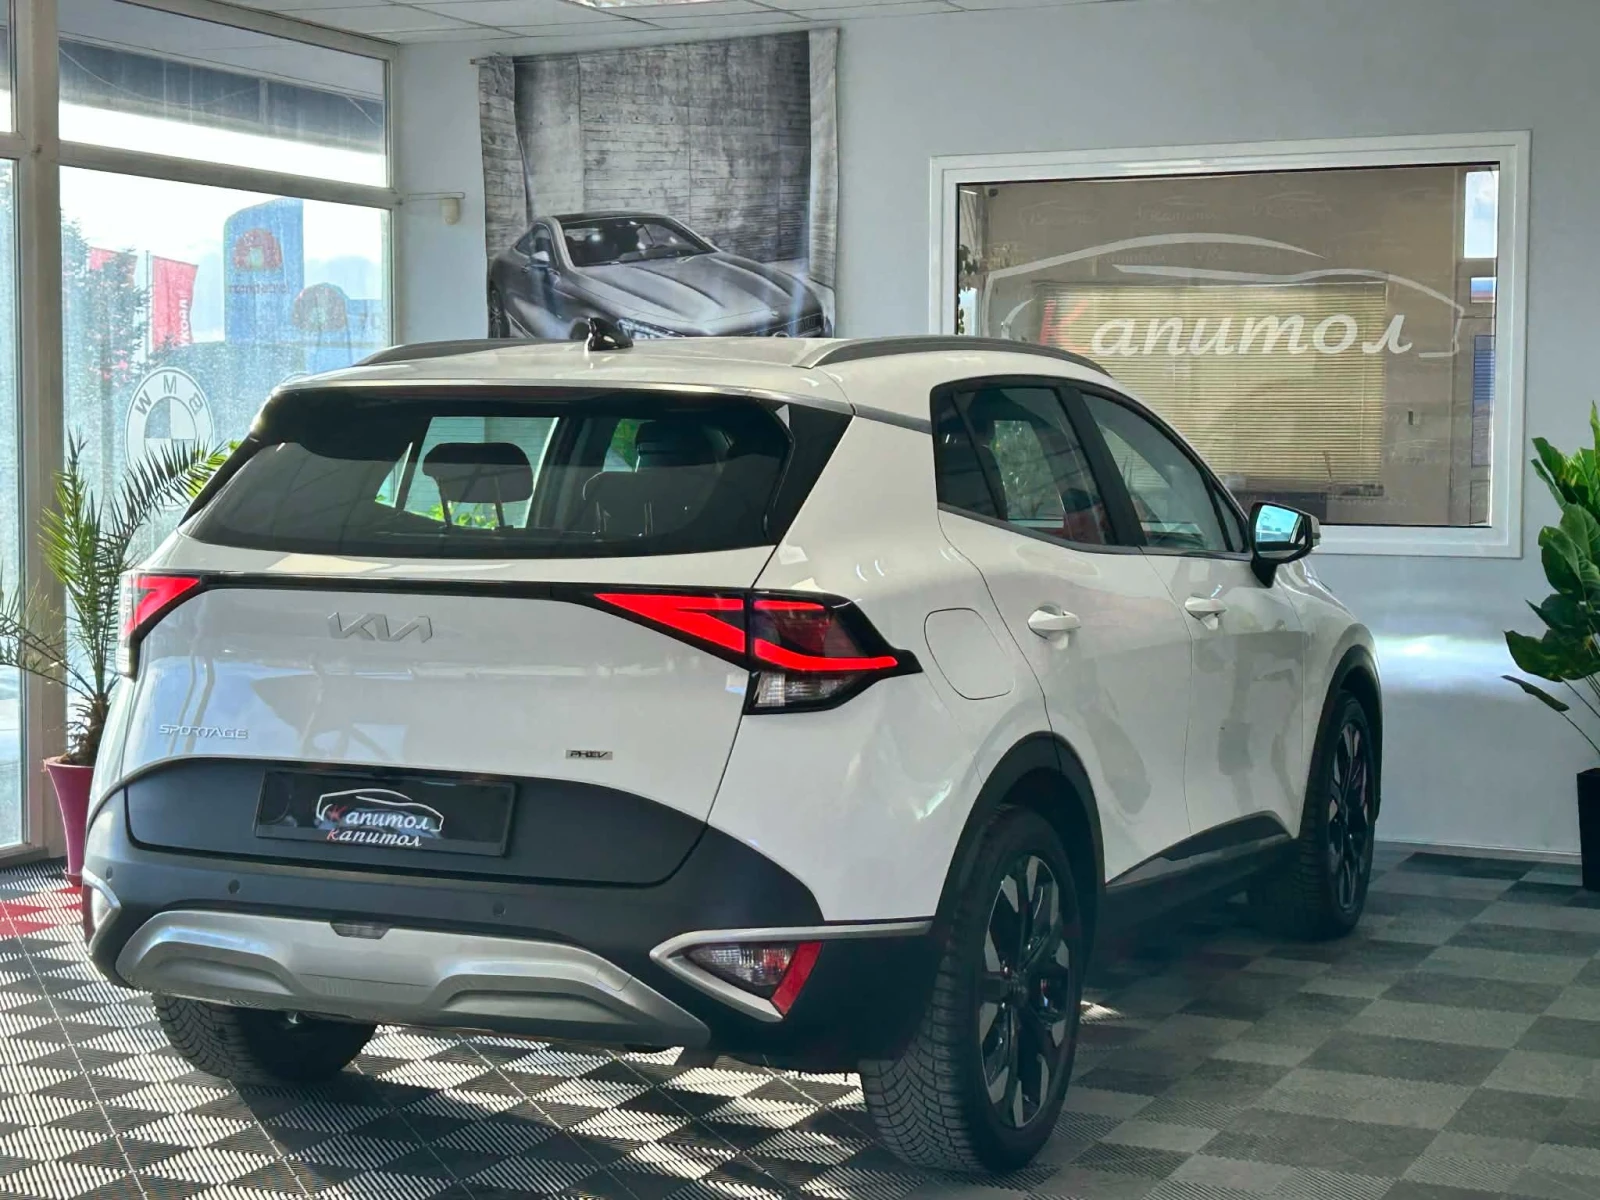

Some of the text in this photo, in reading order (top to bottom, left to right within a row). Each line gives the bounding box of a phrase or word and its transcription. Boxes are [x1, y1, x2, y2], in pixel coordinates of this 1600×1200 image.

[1039, 299, 1412, 356] Капитол
[327, 612, 432, 643] KIA
[159, 724, 249, 740] SPORTAGE
[327, 804, 430, 830] Капитол
